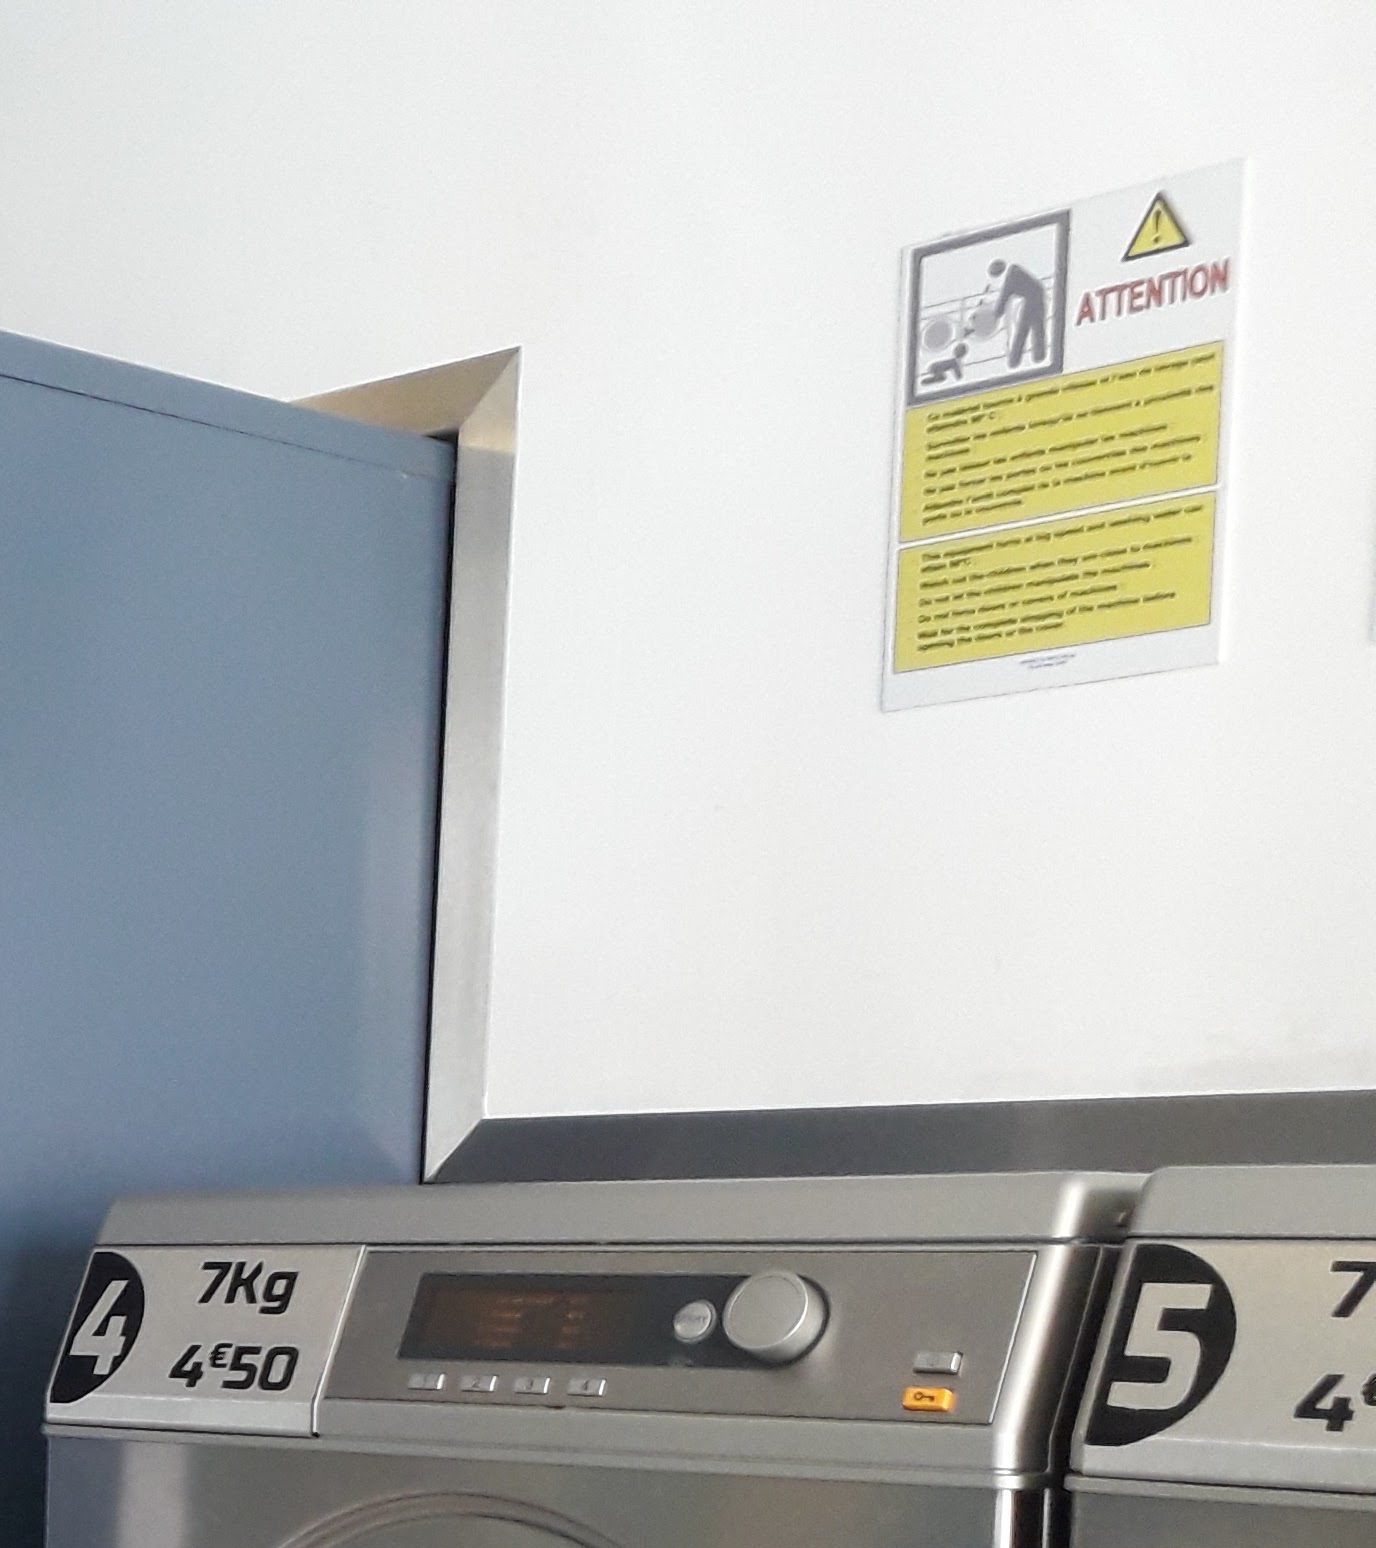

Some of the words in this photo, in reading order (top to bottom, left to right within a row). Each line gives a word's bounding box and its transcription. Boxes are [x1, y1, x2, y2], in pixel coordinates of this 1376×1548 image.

[1075, 256, 1231, 327] ATTENTION
[198, 1260, 300, 1315] 7Kg
[1330, 1260, 1376, 1318] 7
[69, 1279, 130, 1376] 4
[1106, 1282, 1213, 1411] 5
[168, 1342, 300, 1391] 4€50
